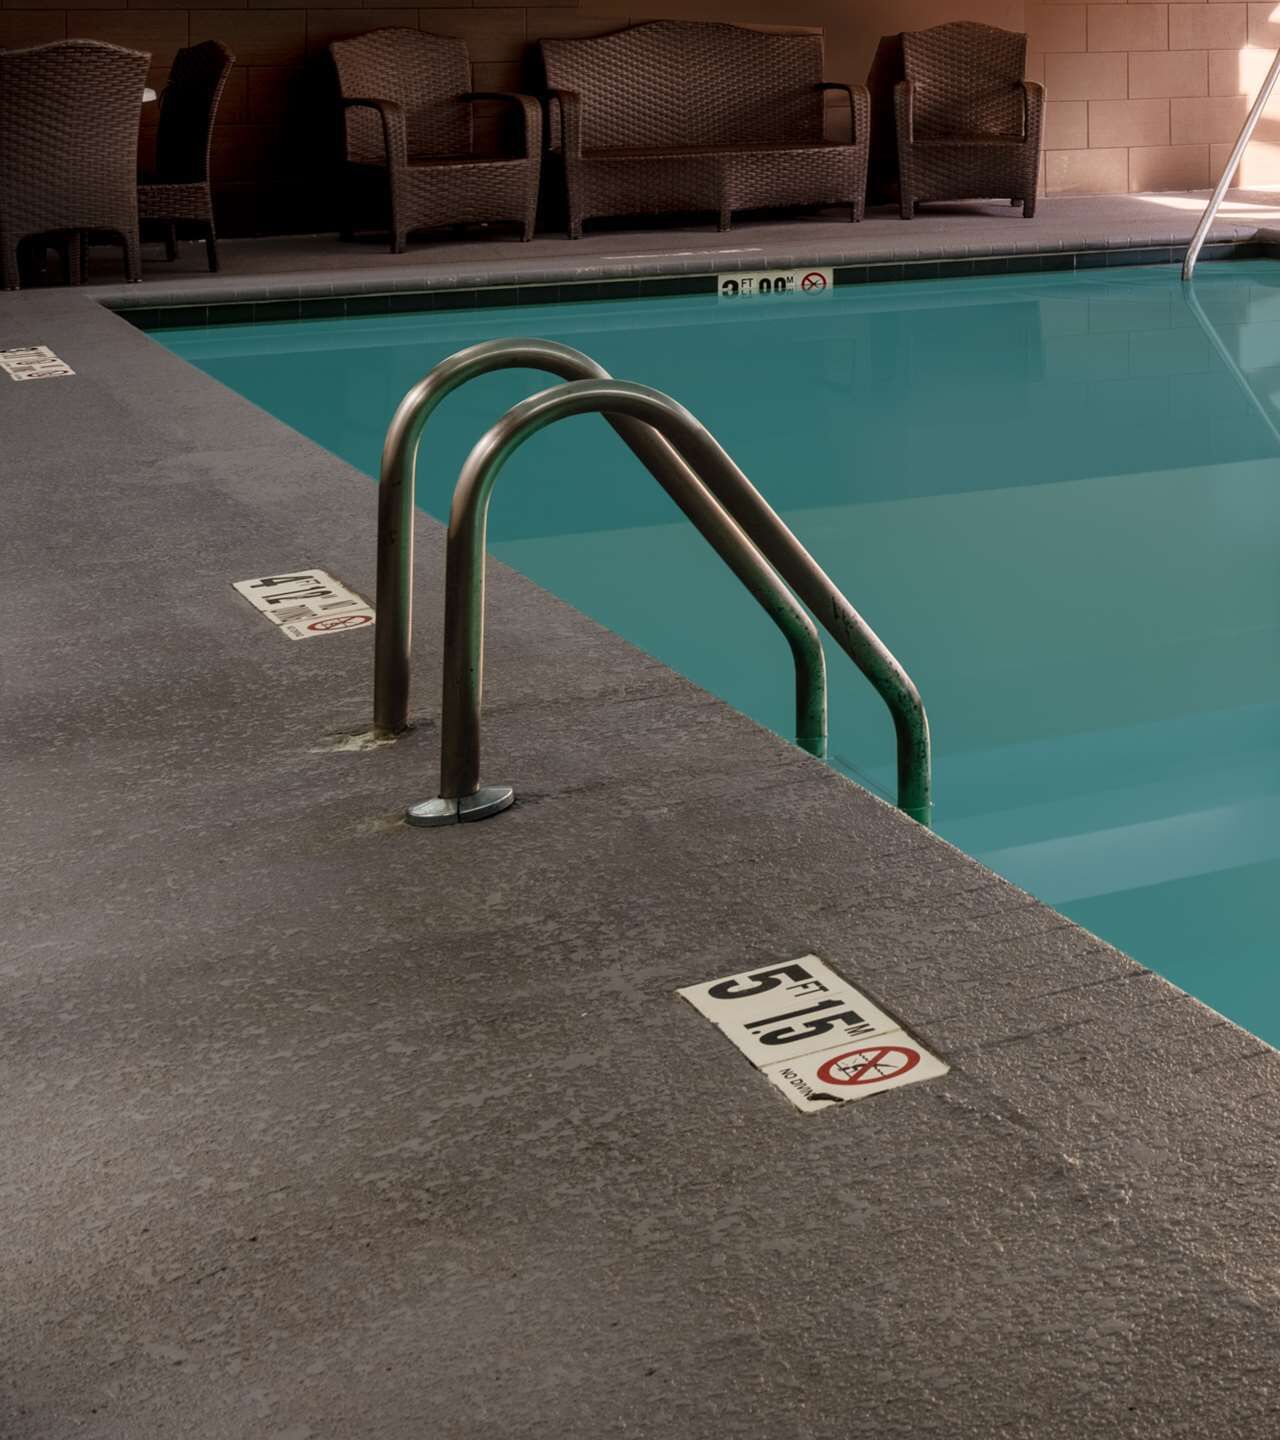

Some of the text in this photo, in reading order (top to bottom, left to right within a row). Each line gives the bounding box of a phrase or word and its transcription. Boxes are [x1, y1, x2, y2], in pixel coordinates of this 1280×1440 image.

[741, 278, 753, 289] FT
[708, 963, 813, 1000] 5
[785, 980, 829, 998] FT
[844, 1023, 876, 1037] M
[779, 1068, 797, 1080] NO
